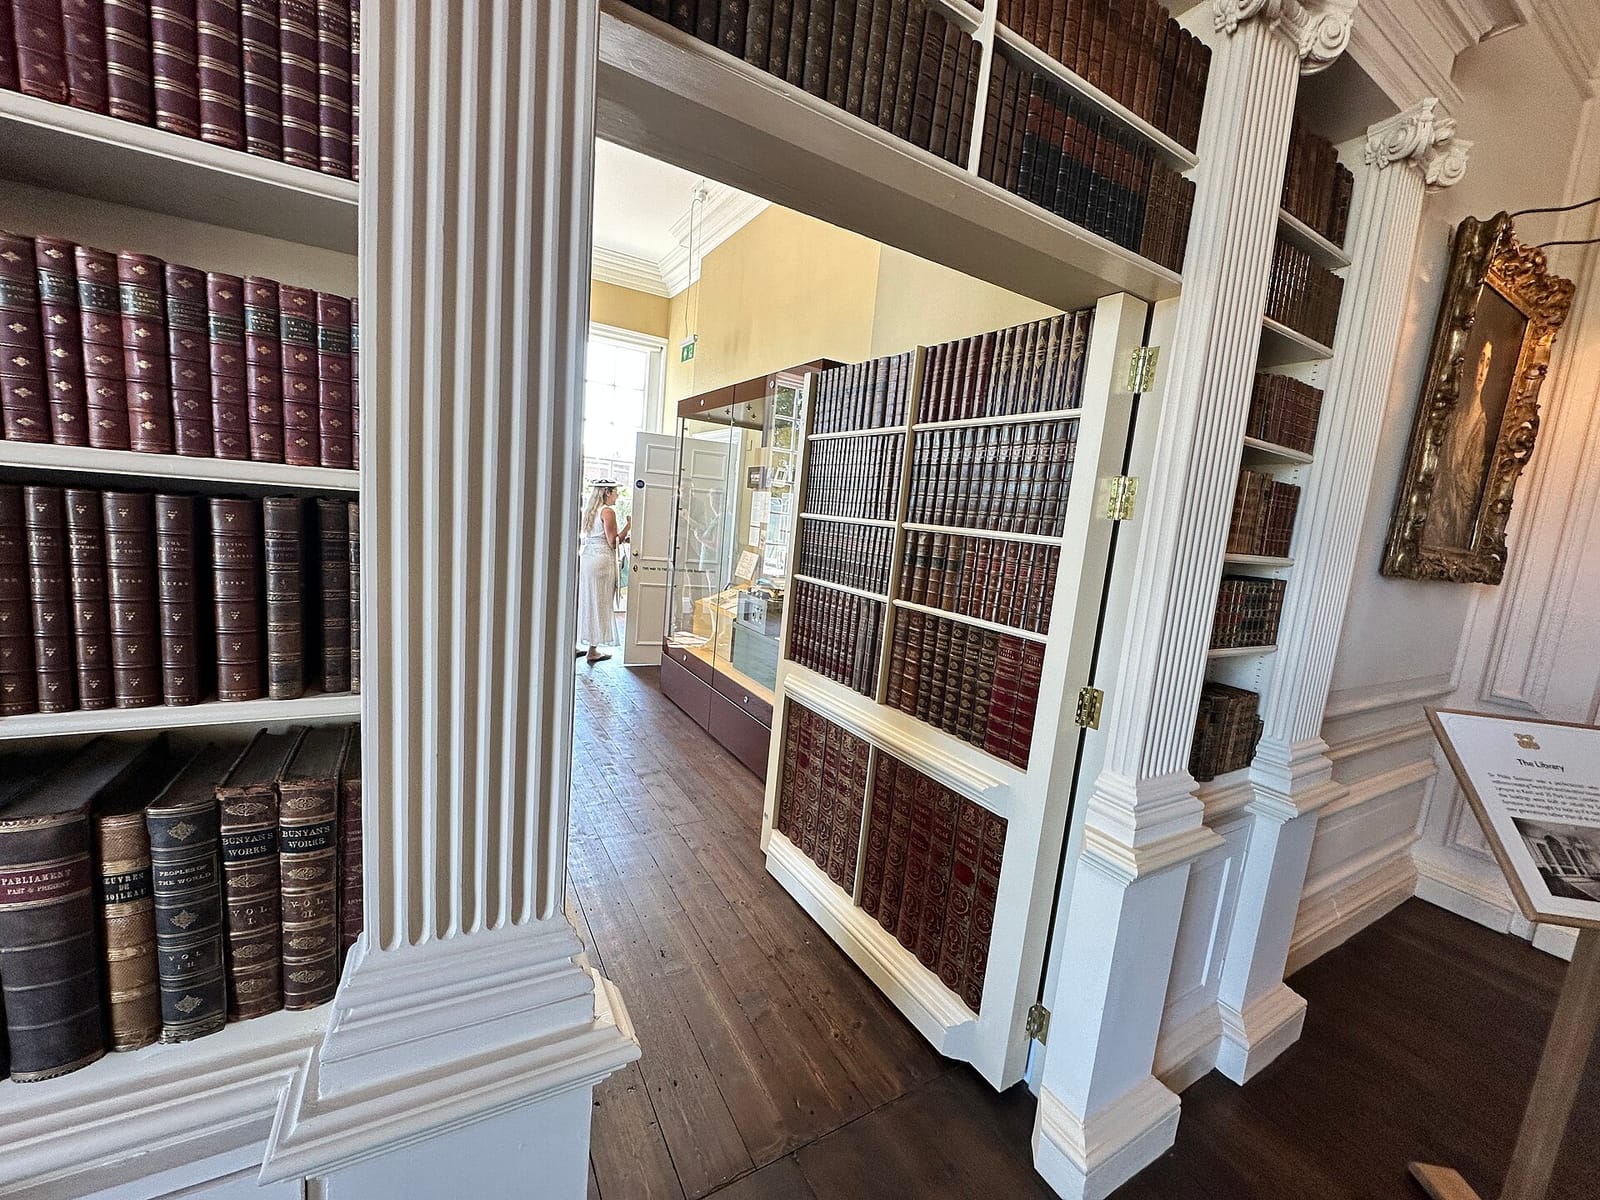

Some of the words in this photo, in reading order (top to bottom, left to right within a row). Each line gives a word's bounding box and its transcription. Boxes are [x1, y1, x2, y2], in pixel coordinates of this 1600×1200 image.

[1516, 758, 1534, 767] The
[1534, 760, 1564, 773] Library
[282, 825, 330, 838] BUNYAN'S
[221, 832, 274, 846] BUNYAN'S
[288, 837, 325, 849] WORKS
[228, 845, 267, 857] WORKS
[1, 868, 73, 886] PARLIAMENT
[159, 867, 196, 877] PEOPLES
[177, 872, 212, 884] WORLD
[7, 887, 26, 896] PAST
[37, 880, 71, 892] PRESENT
[118, 883, 130, 891] DE
